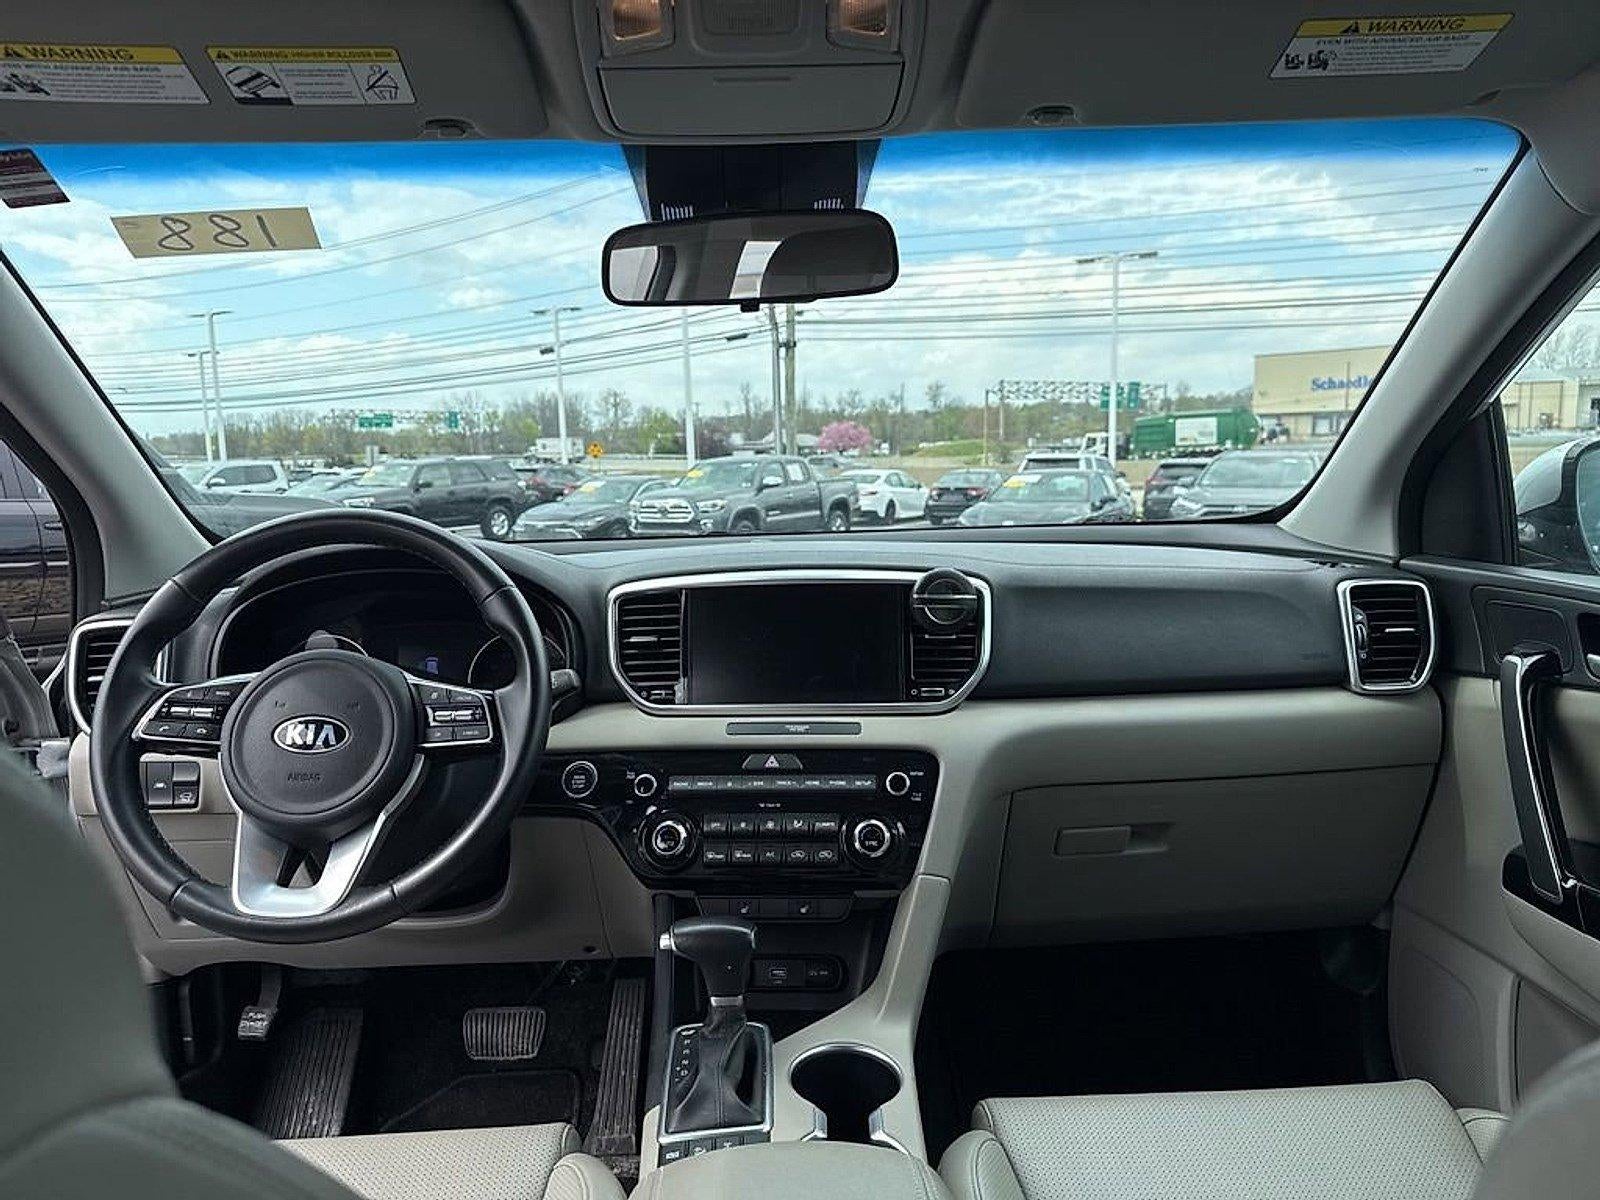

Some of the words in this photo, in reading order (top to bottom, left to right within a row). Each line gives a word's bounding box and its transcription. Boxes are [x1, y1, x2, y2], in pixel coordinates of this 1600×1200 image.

[1367, 18, 1466, 33] WARNING
[26, 46, 134, 61] WARNING
[285, 723, 336, 745] KIA
